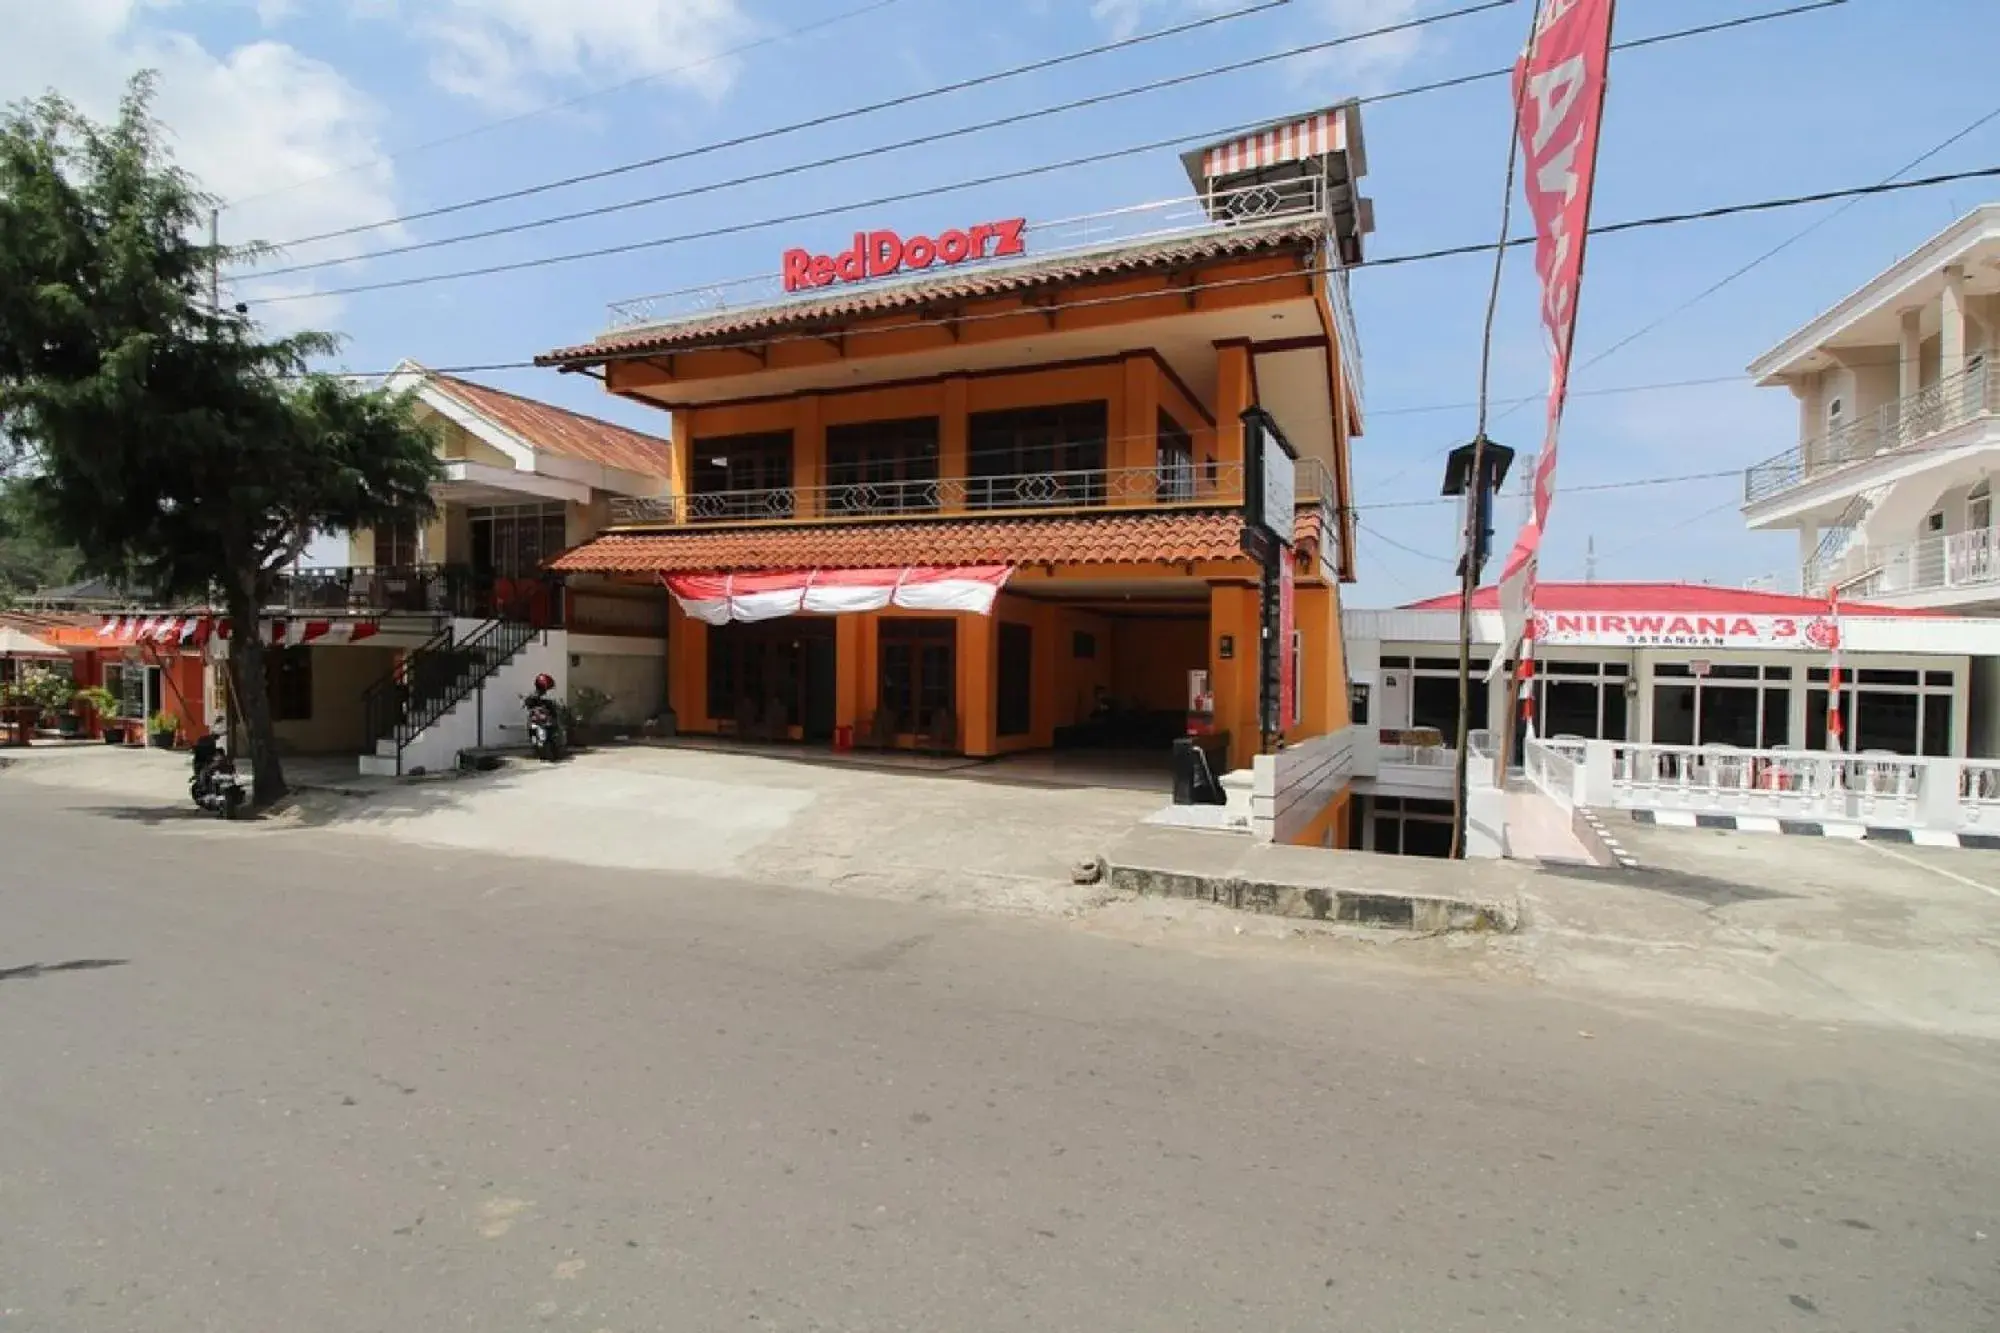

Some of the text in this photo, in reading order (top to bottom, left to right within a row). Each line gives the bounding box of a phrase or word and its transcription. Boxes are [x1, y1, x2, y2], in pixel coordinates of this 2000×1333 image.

[784, 217, 1026, 292] RedDoorz
[1556, 615, 1797, 636] NIRWANA 3
